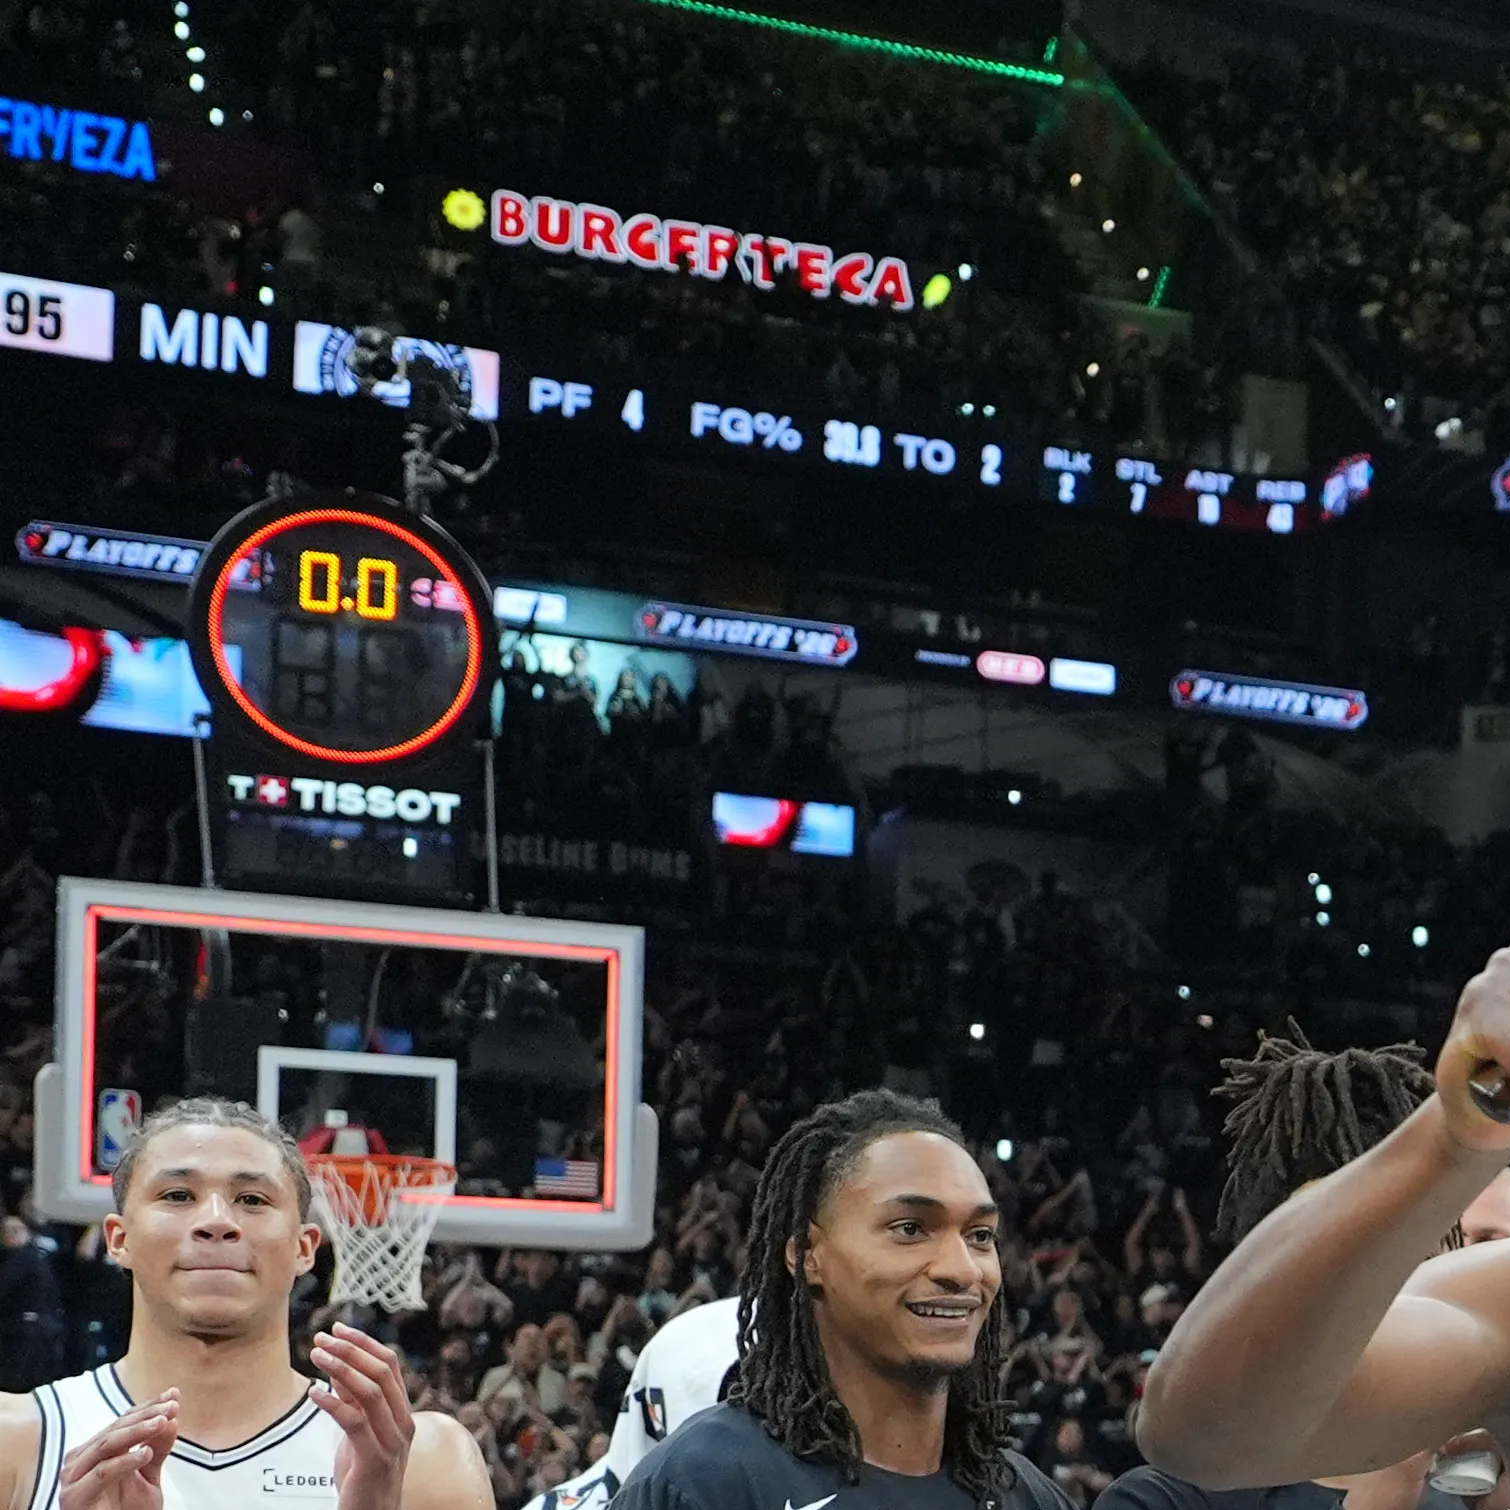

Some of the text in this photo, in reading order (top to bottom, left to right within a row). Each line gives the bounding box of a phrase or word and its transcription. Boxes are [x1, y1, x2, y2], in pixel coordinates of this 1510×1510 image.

[5, 290, 62, 341] 95
[139, 302, 269, 378] MIN
[528, 377, 593, 420] PF
[690, 401, 803, 453] FG%
[892, 432, 957, 476] TO
[42, 530, 201, 575] PLAYOFFS
[299, 551, 398, 620] 0.0
[658, 610, 794, 651] PLAYOFFS
[1192, 678, 1310, 714] PLAYOFFS
[291, 778, 461, 825] TISSOT
